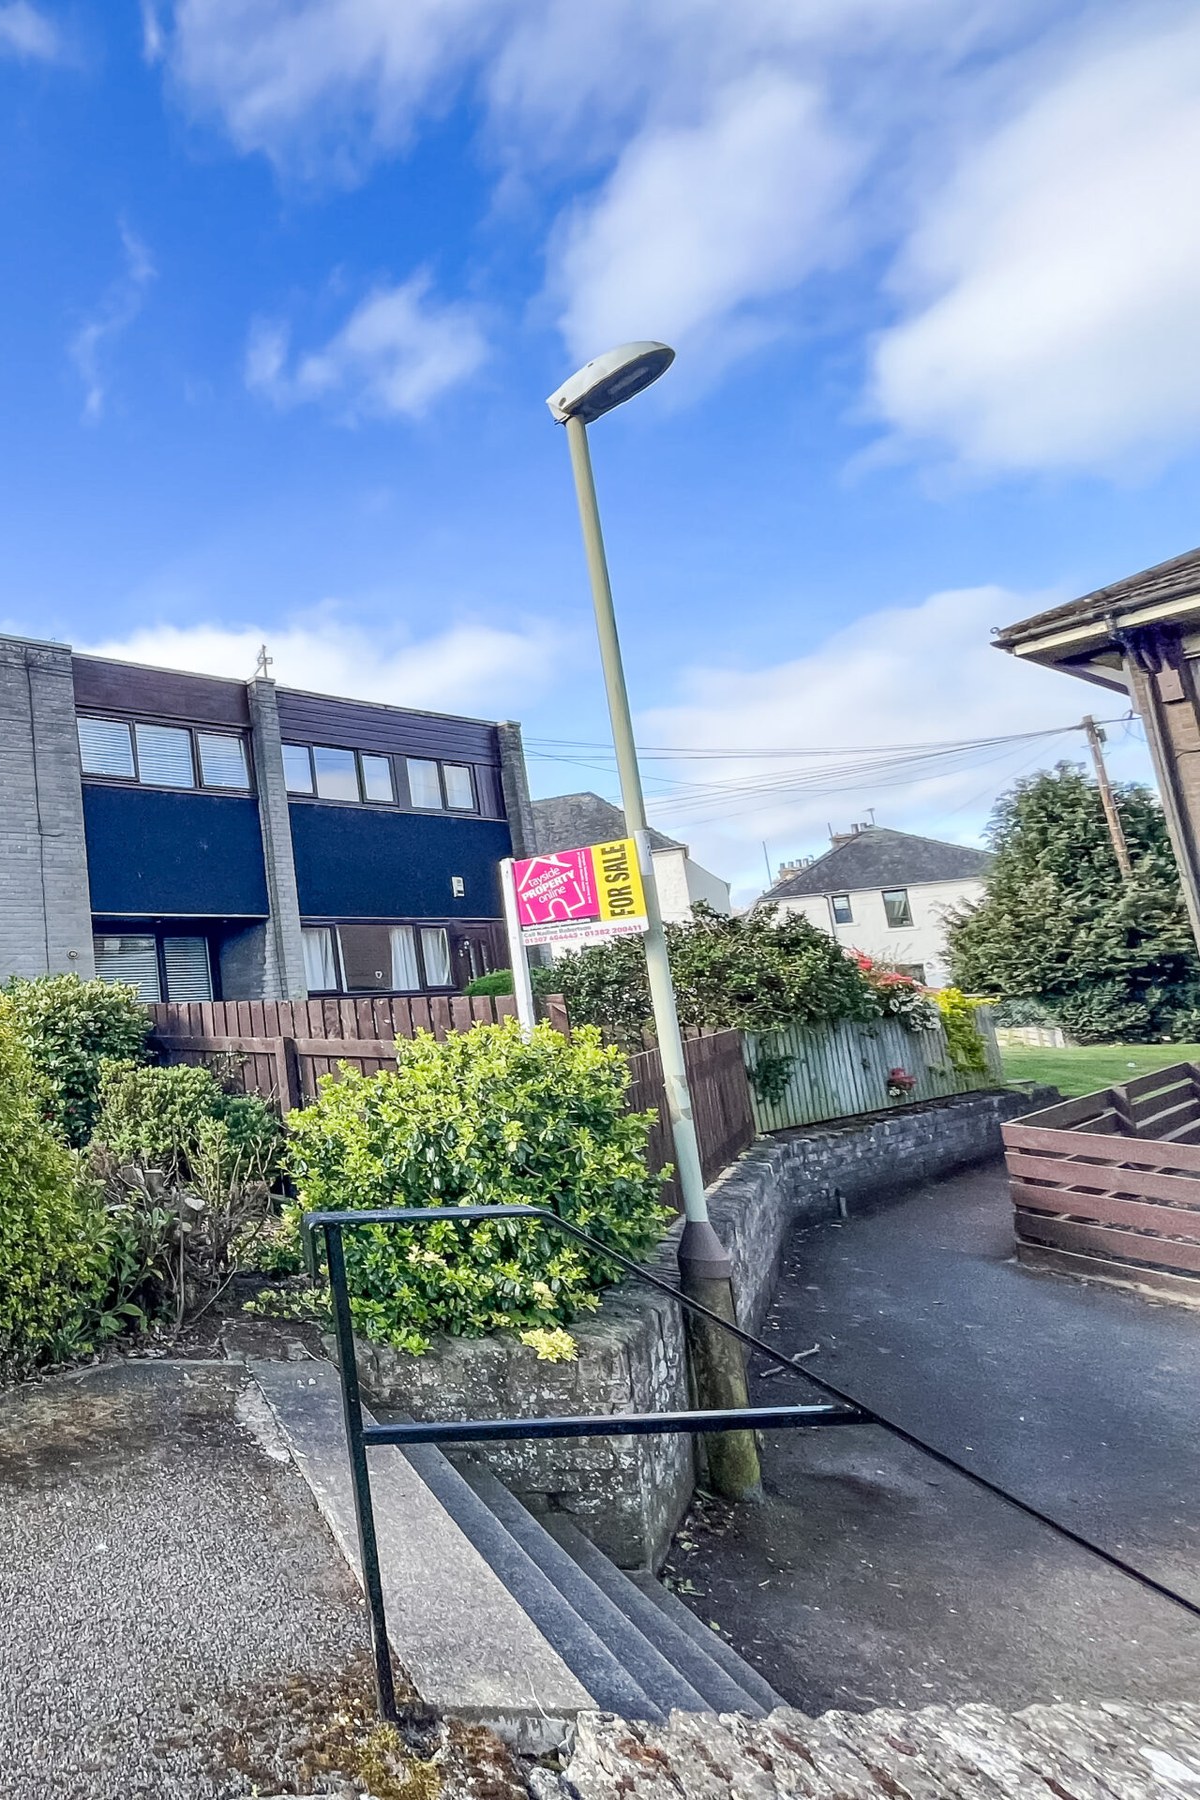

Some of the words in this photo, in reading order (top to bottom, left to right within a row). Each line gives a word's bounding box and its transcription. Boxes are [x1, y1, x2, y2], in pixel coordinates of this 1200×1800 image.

[601, 843, 631, 884] SALE
[521, 869, 575, 902] PROPERTY
[528, 867, 561, 887] tayside
[538, 886, 567, 904] online
[607, 885, 635, 917] FOR
[584, 928, 610, 937] 01382
[612, 924, 642, 934] 200411
